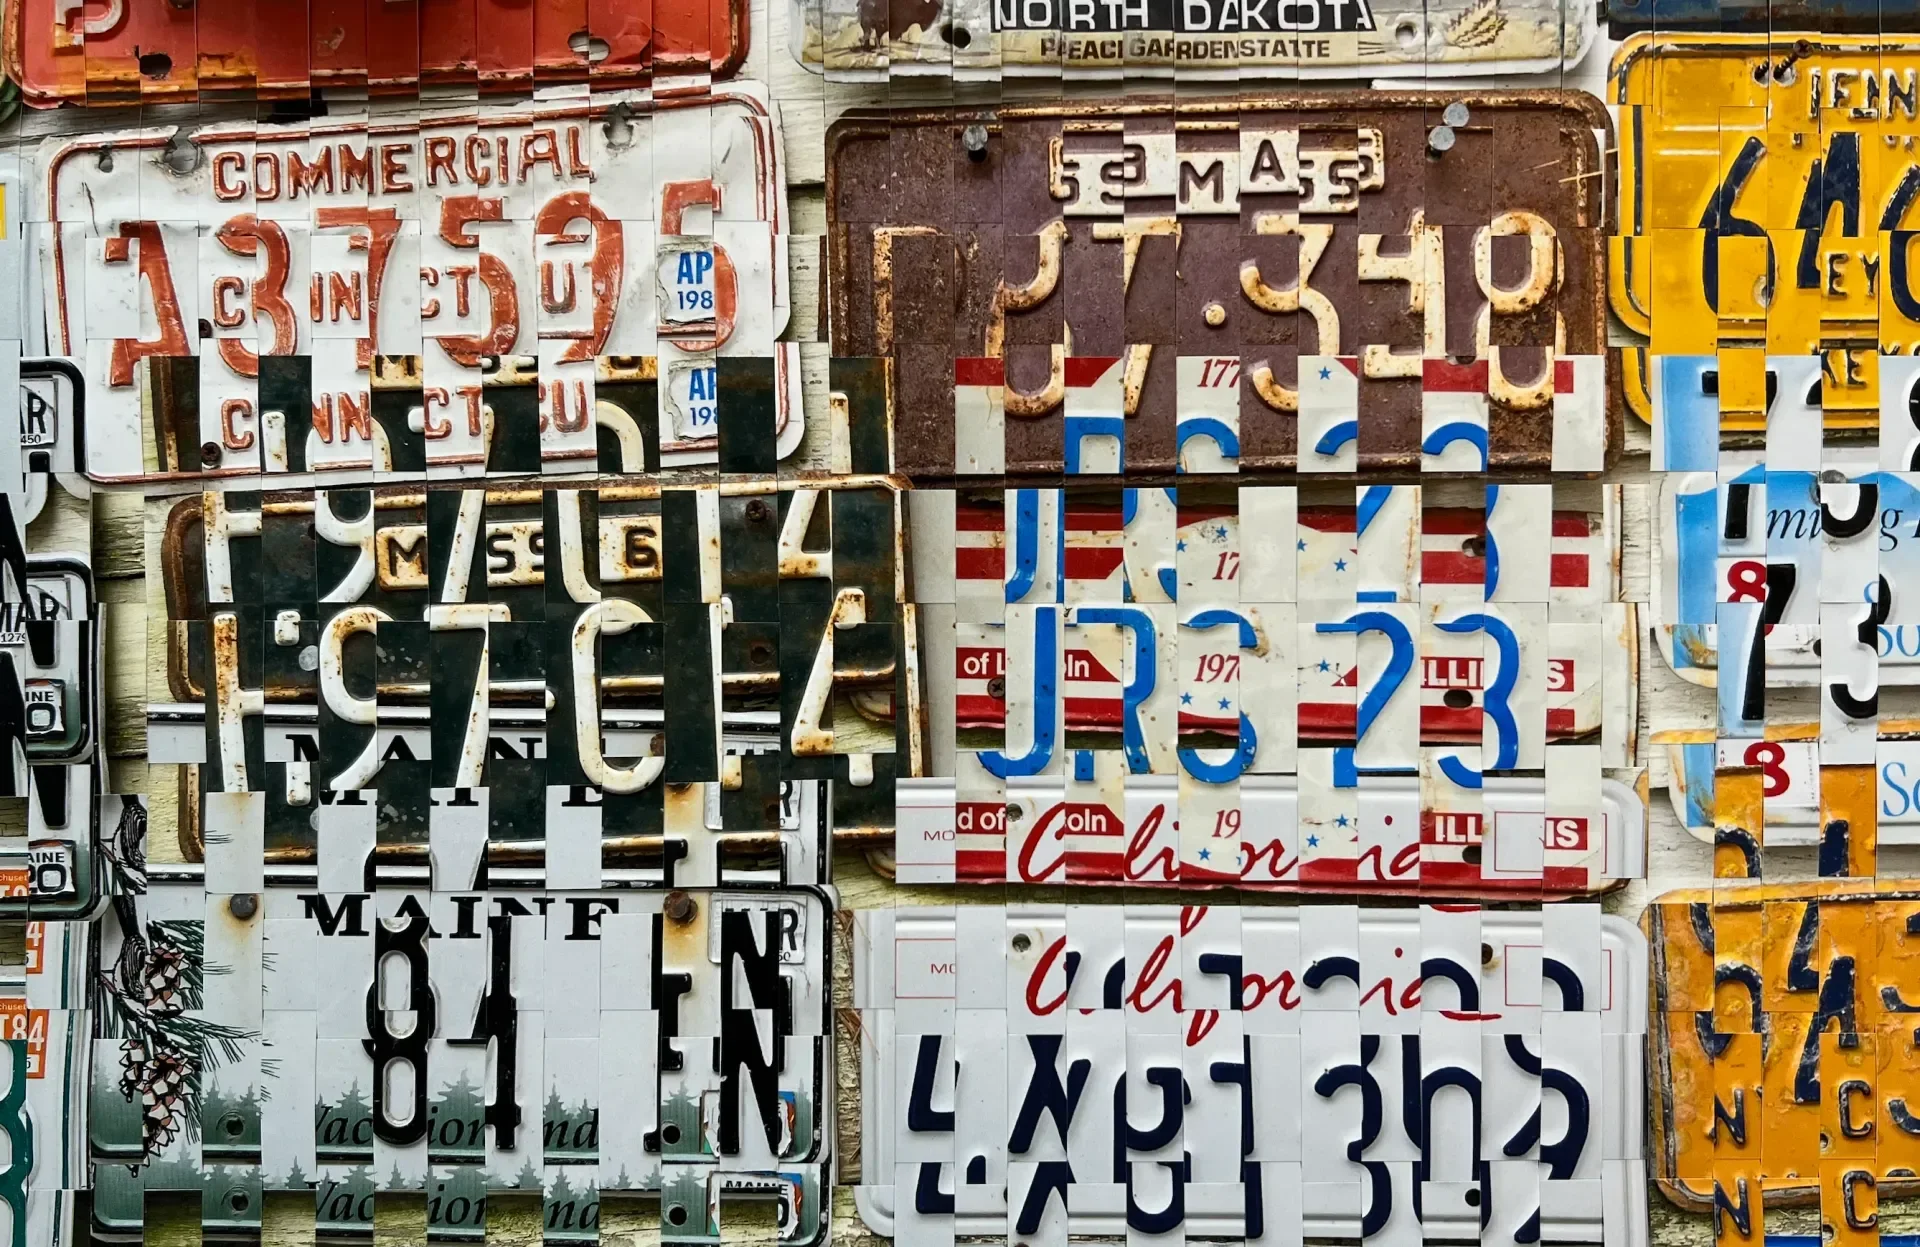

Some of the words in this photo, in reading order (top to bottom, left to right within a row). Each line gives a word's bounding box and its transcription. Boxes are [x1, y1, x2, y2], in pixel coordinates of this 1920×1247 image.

[995, 0, 1149, 29] NORTH
[1183, 0, 1376, 30] DAKOTA
[212, 127, 595, 202] COMMERCIAL
[677, 252, 714, 284] AP
[678, 290, 714, 309] 198
